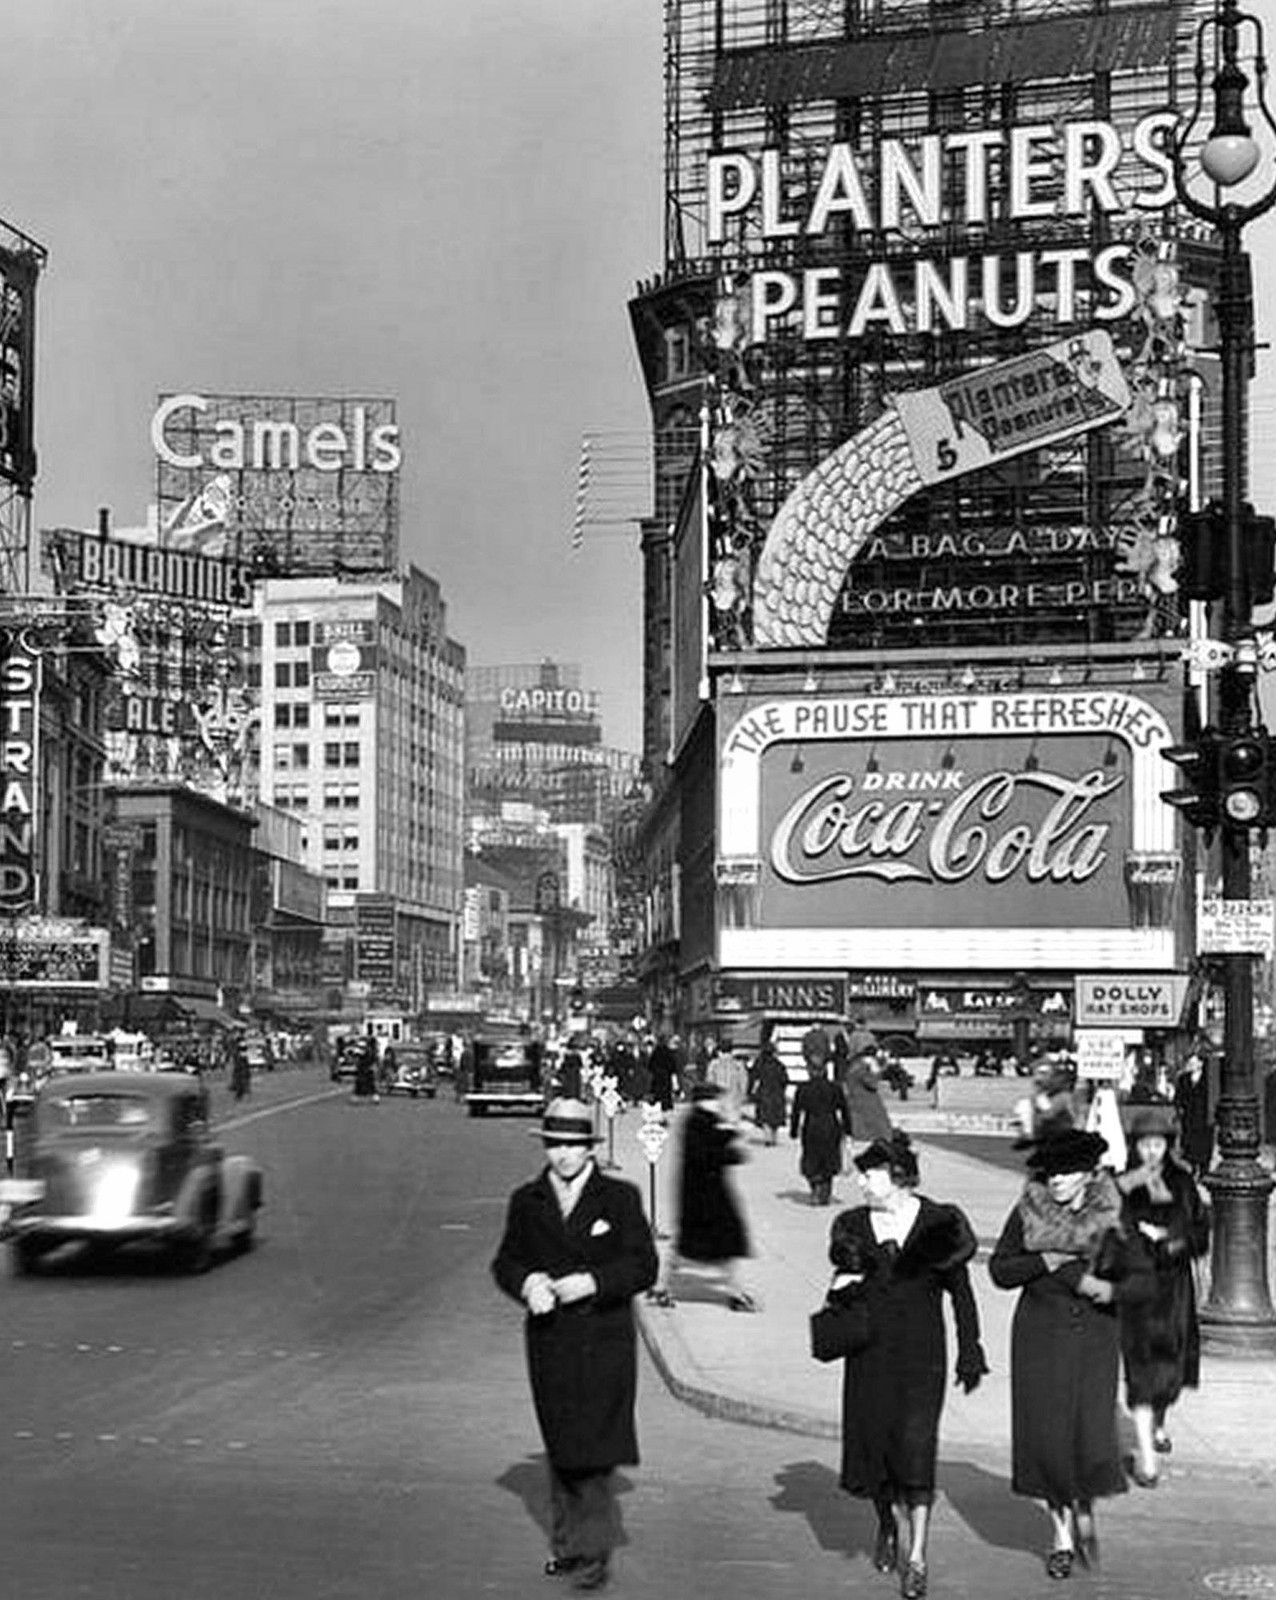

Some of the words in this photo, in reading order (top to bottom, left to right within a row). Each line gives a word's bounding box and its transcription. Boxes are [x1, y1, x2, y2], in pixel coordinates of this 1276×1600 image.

[706, 113, 1180, 243] PLANTERS
[751, 245, 1138, 345] PEANUTS
[948, 361, 1072, 440] Planters
[151, 395, 401, 471] Camels
[867, 538, 889, 560] A
[911, 532, 986, 557] BAG
[1007, 530, 1028, 554] A
[1049, 524, 1121, 551] DAY
[931, 583, 1044, 608] MORE
[1065, 579, 1136, 603] PEP
[126, 697, 176, 734] ALE
[500, 687, 600, 712] CAPITOL
[728, 707, 785, 754] THE
[794, 703, 888, 734] PAUSE
[900, 700, 978, 731] THAT
[991, 697, 1165, 748] REFRESHES
[0, 656, 33, 897] STRAND
[861, 770, 964, 792] DRINK
[771, 771, 1125, 884] Coca-Cola
[1092, 985, 1163, 1001] DOLLY
